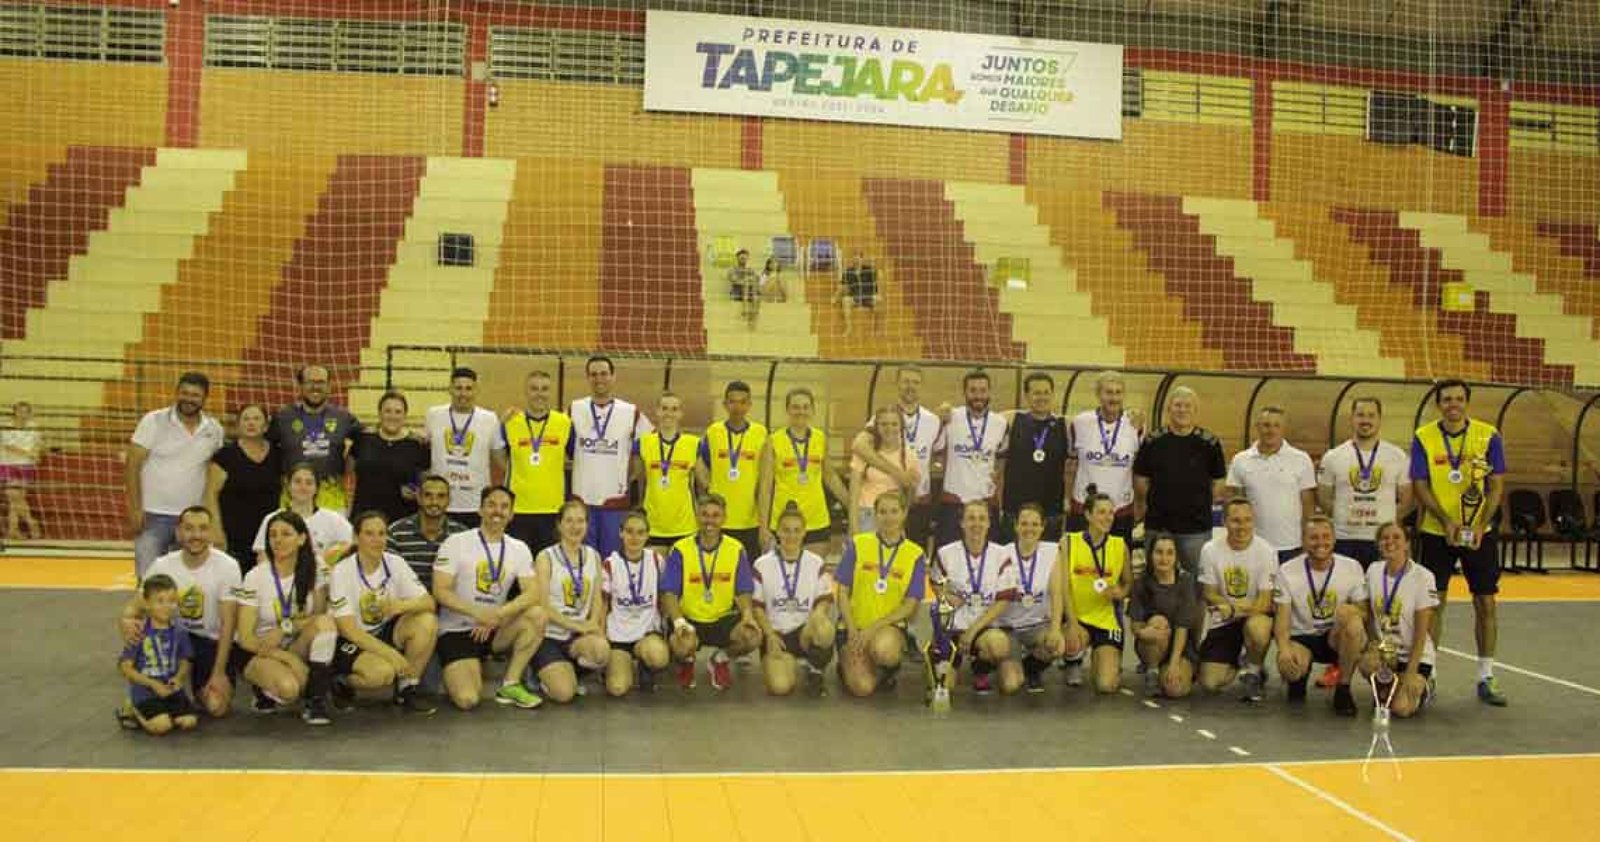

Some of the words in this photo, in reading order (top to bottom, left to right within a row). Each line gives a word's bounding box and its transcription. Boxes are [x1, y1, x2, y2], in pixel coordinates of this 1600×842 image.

[742, 27, 881, 51] PREFEITURA
[891, 37, 920, 53] DE
[696, 41, 960, 103] TAPEJARA
[981, 55, 1058, 74] JUNTOS
[1003, 74, 1066, 89] MAIORES
[990, 100, 1047, 113] DESAFIO
